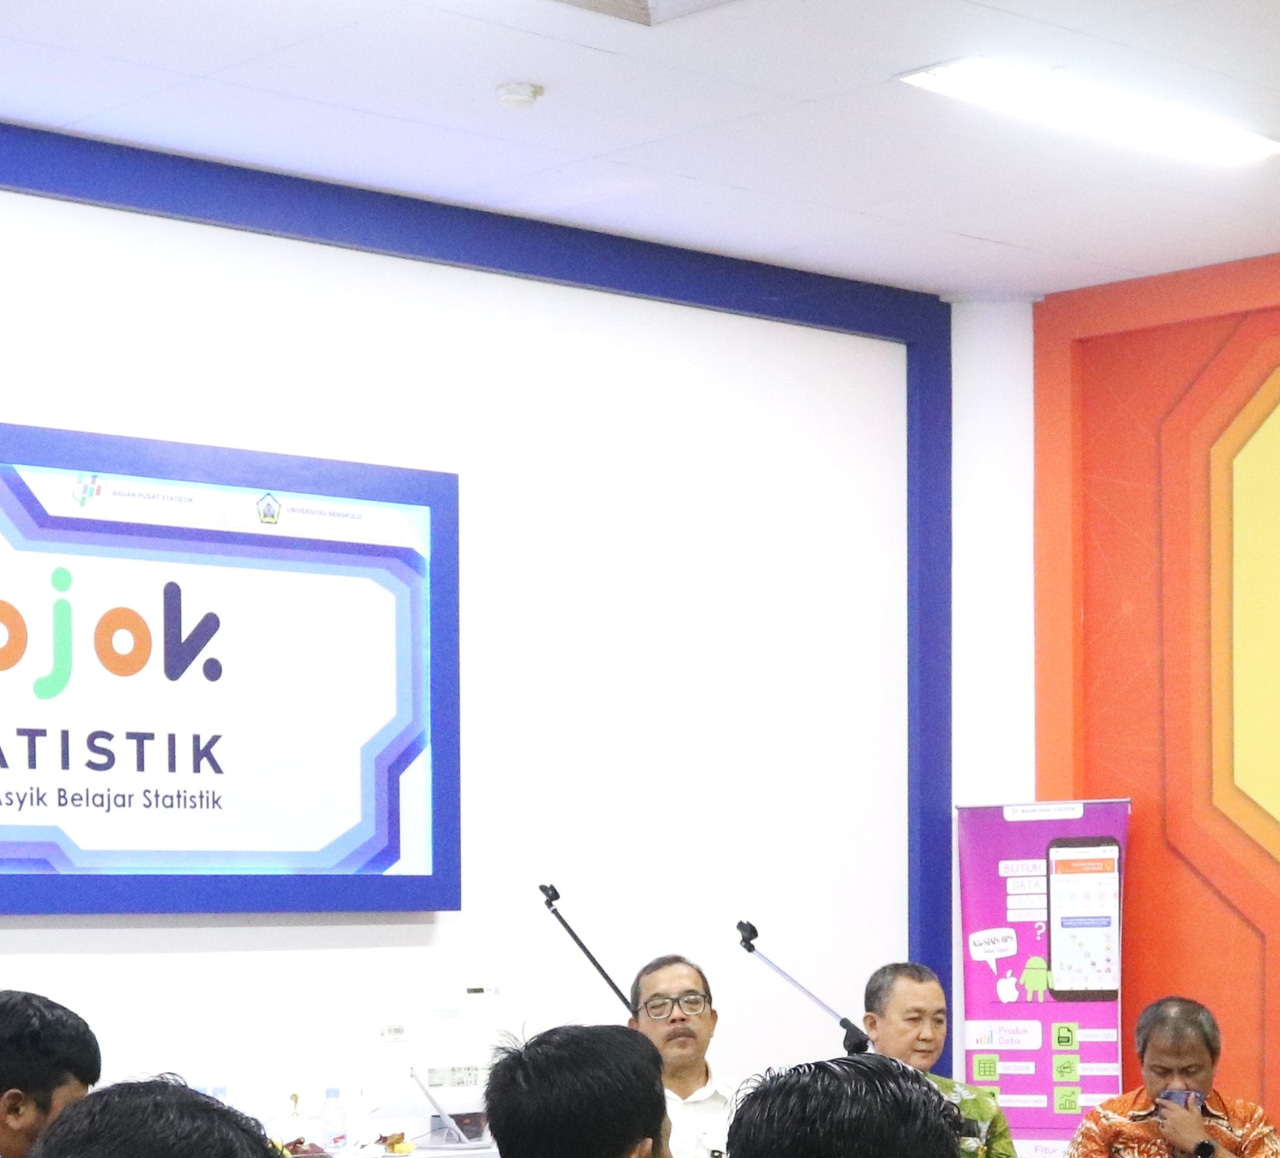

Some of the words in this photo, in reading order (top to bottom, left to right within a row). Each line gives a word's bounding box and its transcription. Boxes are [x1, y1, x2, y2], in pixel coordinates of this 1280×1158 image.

[58, 788, 134, 813] Belajar
[143, 790, 223, 809] Statistik
[1003, 863, 1041, 875] BUTUH
[1012, 880, 1041, 891] DATA
[998, 1027, 1029, 1036] Produk
[998, 1036, 1021, 1044] Data
[1034, 1146, 1058, 1154] Fitur
